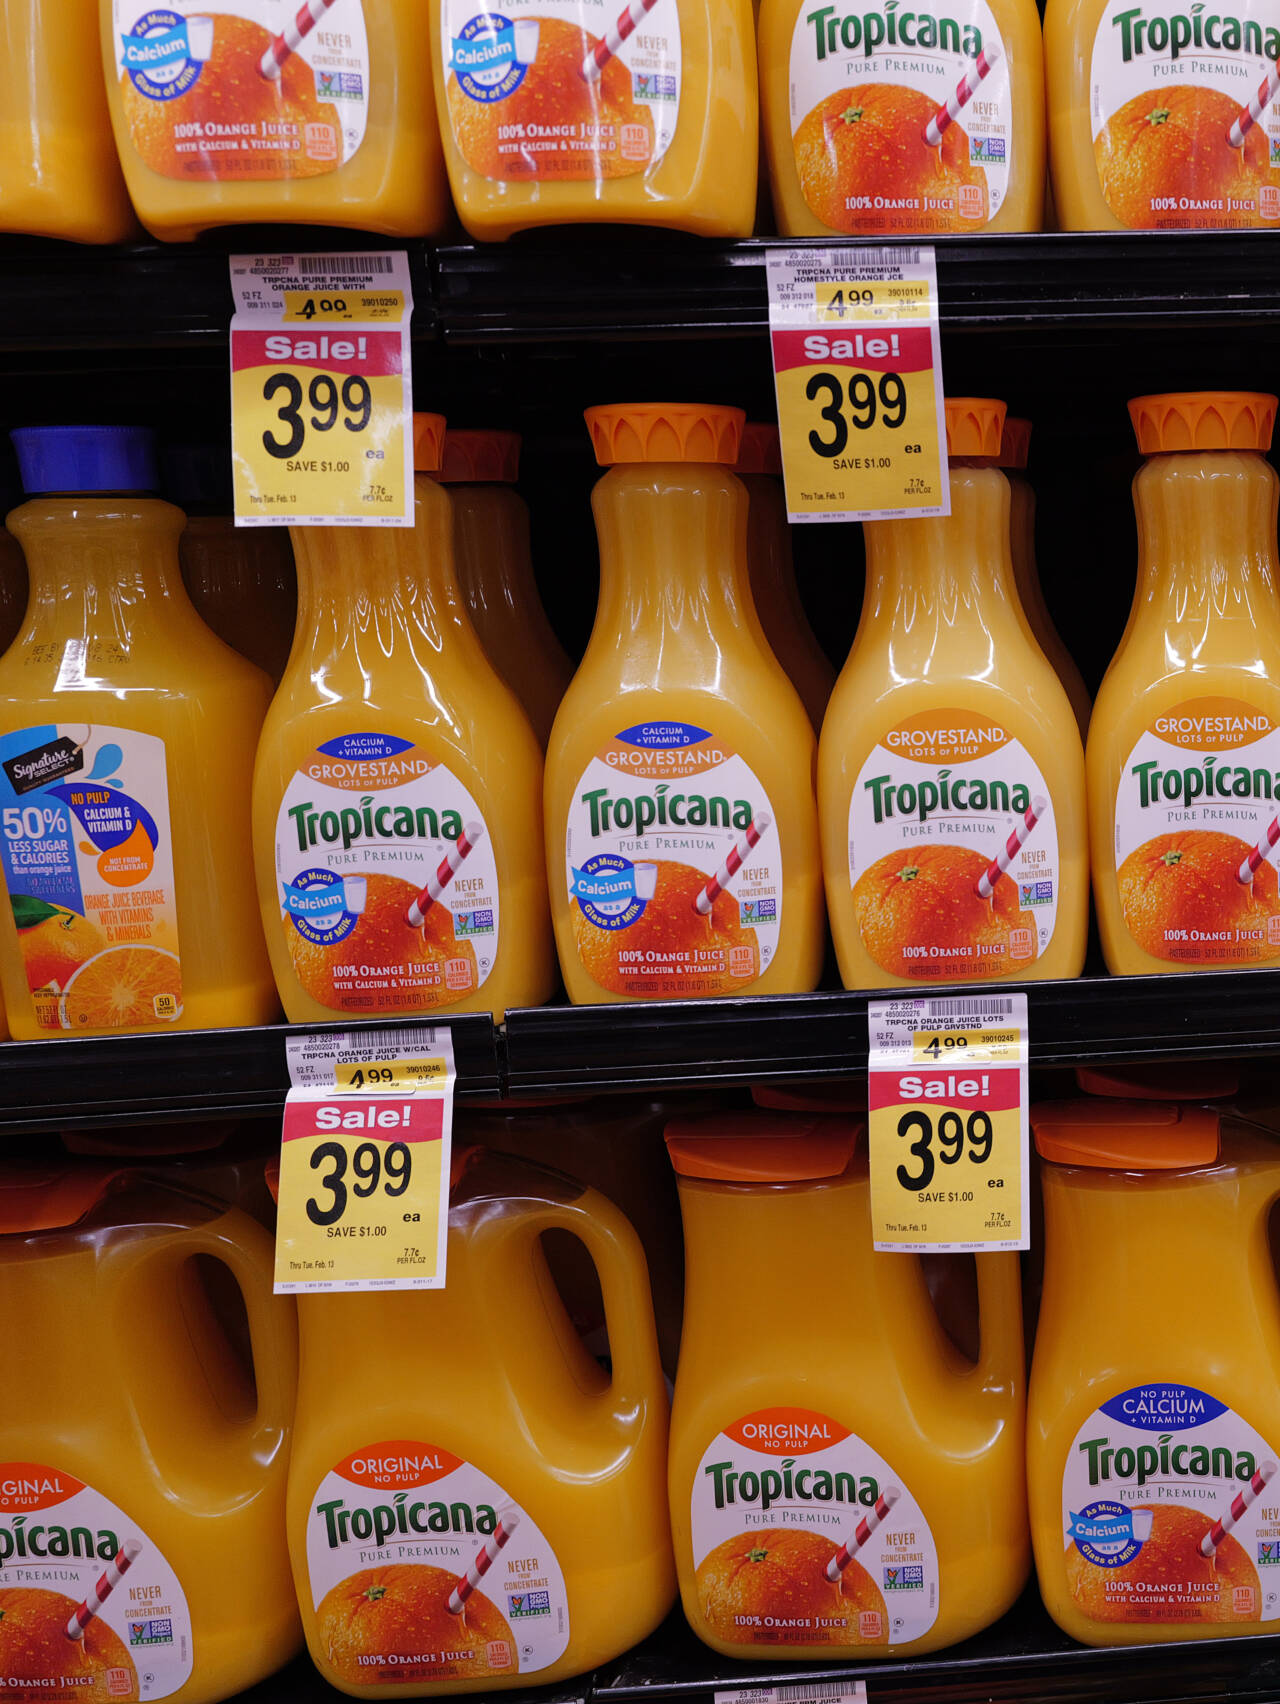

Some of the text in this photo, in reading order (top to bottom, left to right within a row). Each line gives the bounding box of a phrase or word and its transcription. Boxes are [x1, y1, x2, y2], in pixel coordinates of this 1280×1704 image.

[807, 5, 983, 60] Tropicana
[127, 38, 186, 61] Calcium
[455, 41, 512, 64] Calcium
[847, 59, 945, 75] PURE PREMIUM
[1153, 61, 1248, 78] PURE PREMIUM
[973, 102, 998, 116] NEVER
[174, 122, 298, 138] 100% ORANGE JUICE
[845, 197, 953, 210] 100% ORANGE JUICE
[794, 275, 846, 283] HOMESTYLE
[265, 336, 366, 360] Sale!
[804, 334, 900, 359] Sale!
[366, 450, 385, 459] ea
[287, 461, 349, 472] SAVE $1.00
[1155, 716, 1271, 733] GROVESTAND
[887, 728, 1007, 746] GROVESTAND
[14, 749, 68, 780] Signature
[34, 758, 70, 777] SELECT
[606, 751, 728, 766] GROVESTAND
[309, 761, 433, 779] GROVESTAND
[338, 779, 361, 788] LOTS
[376, 778, 398, 786] PULP
[71, 792, 110, 804] NO PULP
[864, 770, 1030, 823] Tropicana
[582, 784, 752, 837] Tropicana
[3, 807, 67, 840] 50%
[288, 796, 463, 851] Tropicana
[903, 823, 996, 837] PURE PREMIUM
[8, 840, 68, 852] LESS SUGAR
[289, 890, 342, 910] Calcium
[899, 1075, 990, 1099] Sale!
[315, 1106, 411, 1129] Sale!
[918, 1192, 973, 1203] SAVE $1.00
[1140, 1390, 1186, 1399] NO PULP
[1122, 1399, 1205, 1415] CALCIUM
[743, 1423, 831, 1439] ORIGINAL
[351, 1455, 443, 1474] ORIGINAL
[1079, 1434, 1256, 1486] Tropicana
[705, 1458, 879, 1510] Tropicana
[317, 1493, 498, 1548] Tropicana
